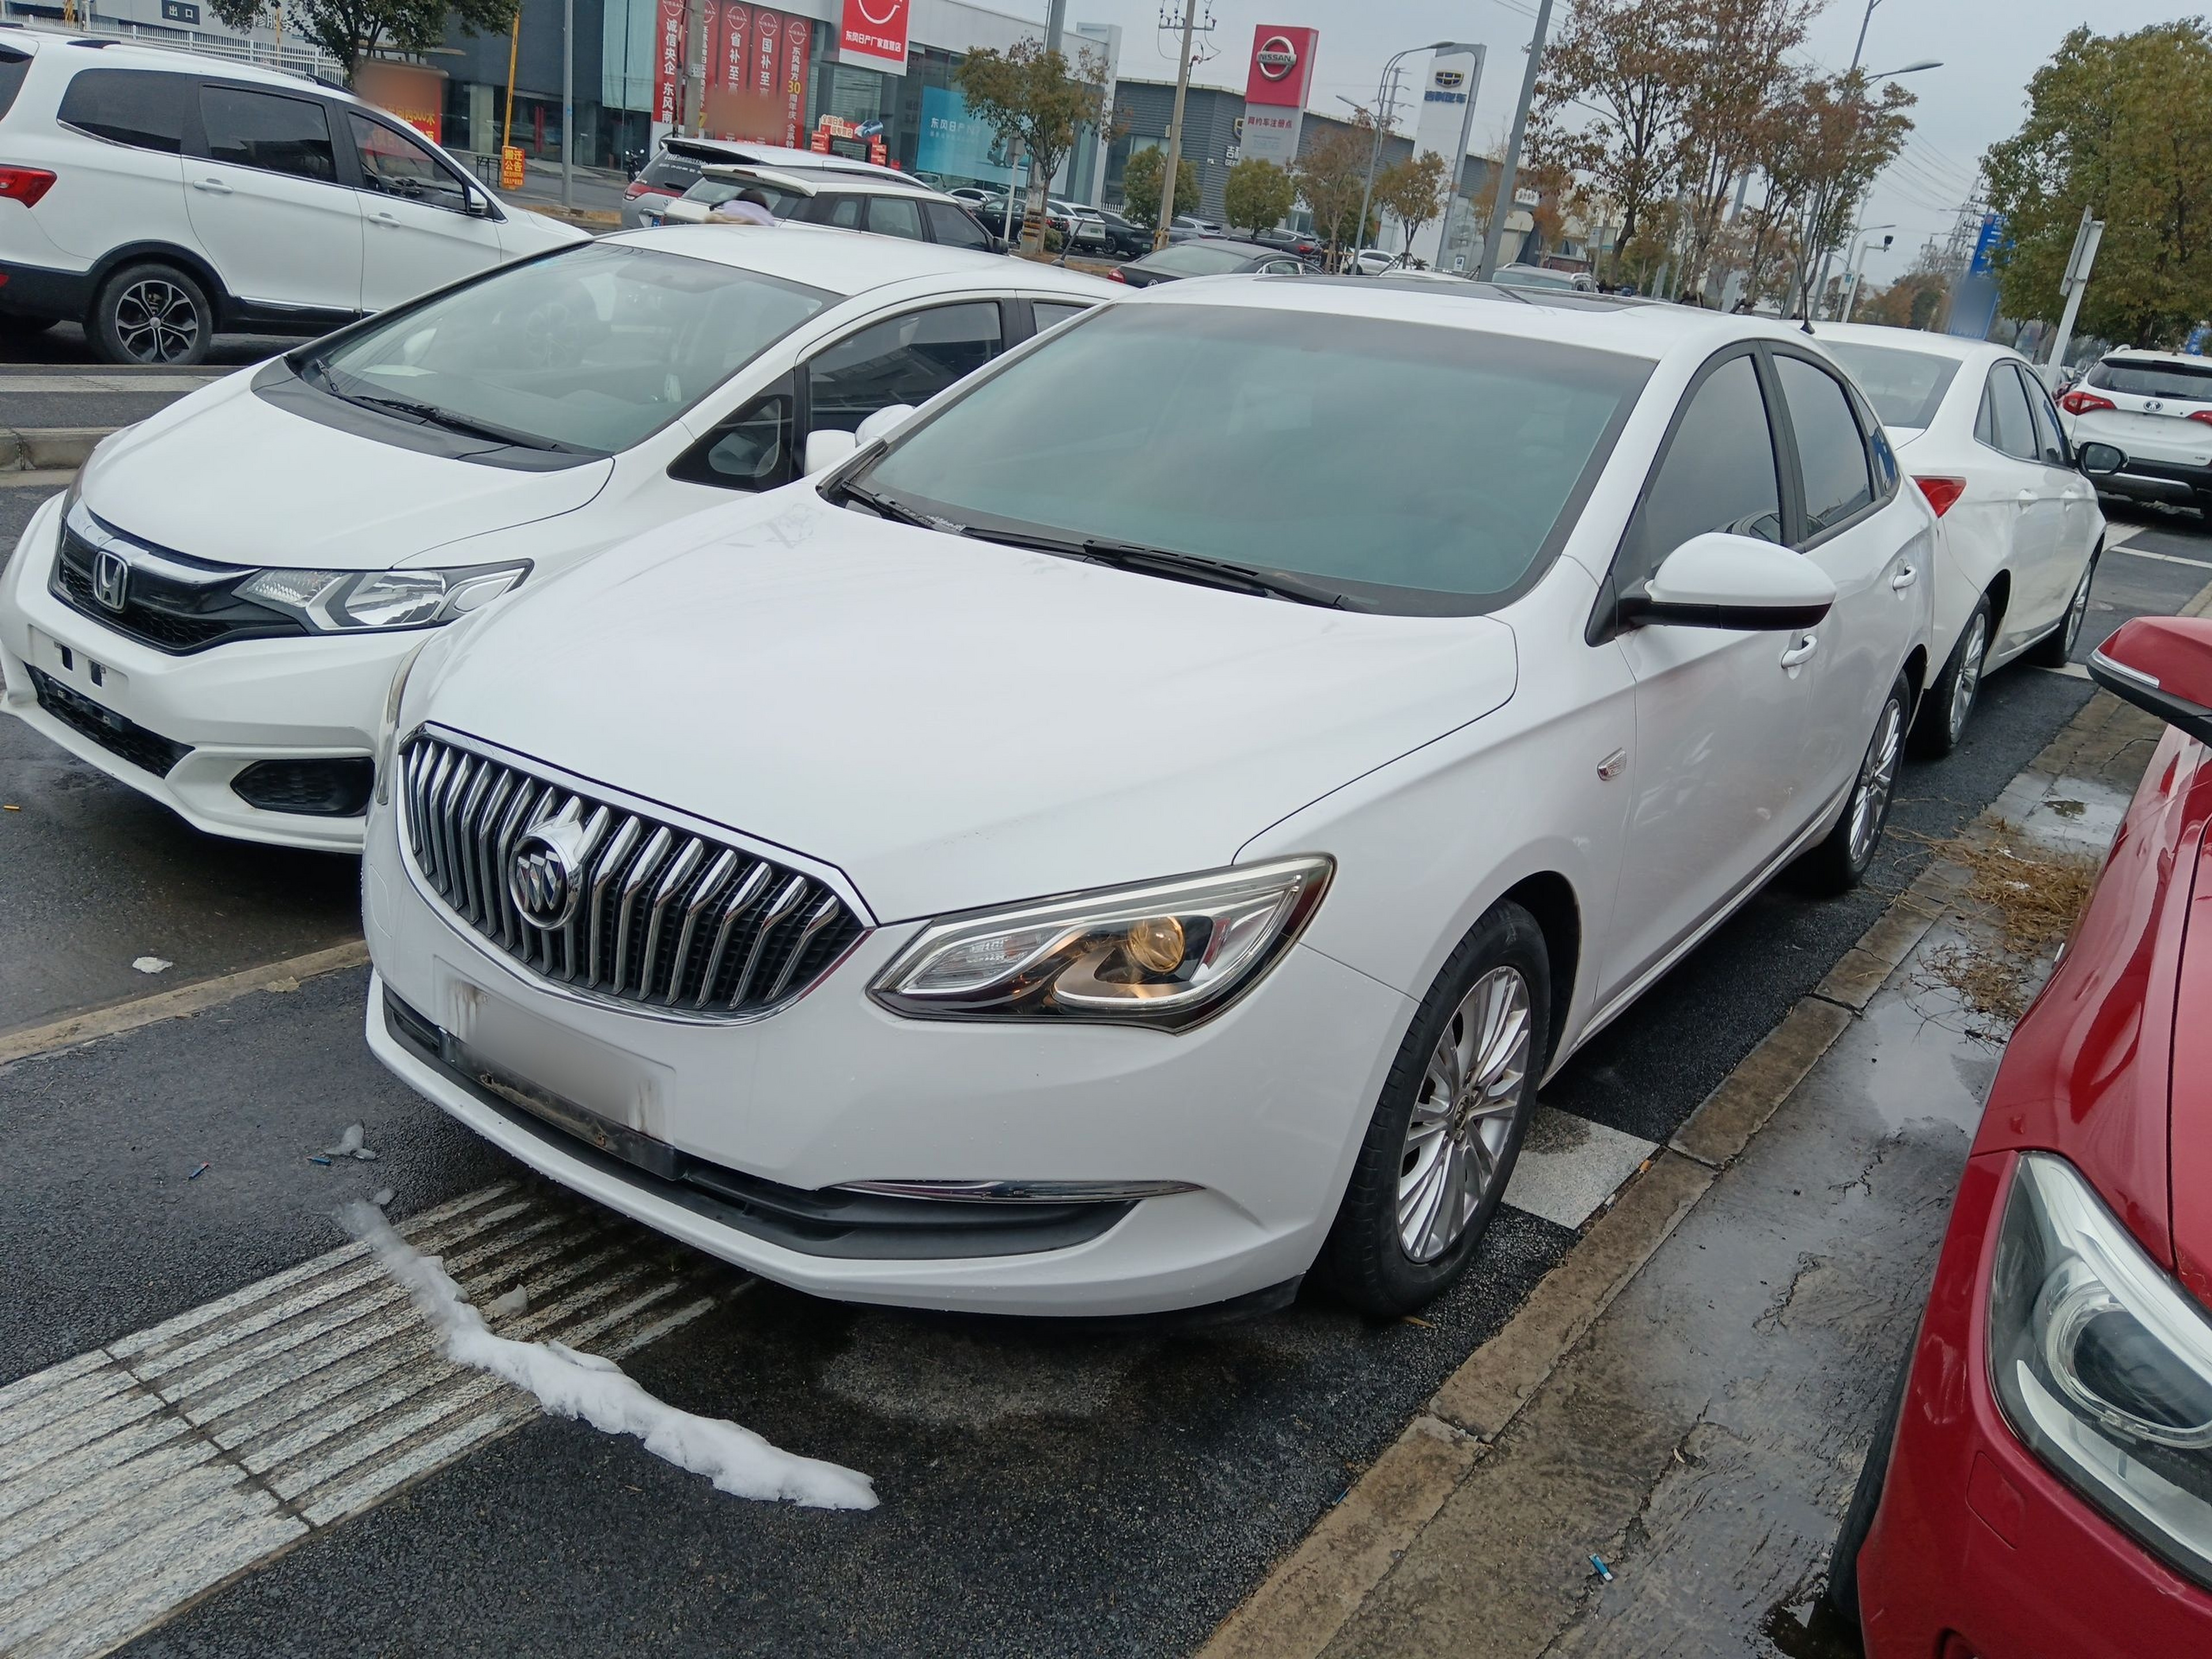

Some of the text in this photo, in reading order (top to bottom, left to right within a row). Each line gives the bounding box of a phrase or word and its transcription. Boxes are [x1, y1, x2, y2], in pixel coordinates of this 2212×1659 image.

[169, 5, 194, 18] 出口
[727, 14, 747, 22] NISSAN
[759, 20, 778, 28] NISSAN
[789, 29, 807, 37] NISSAN
[664, 18, 678, 75] 诚信央企
[845, 30, 902, 52] 东风日产厂家直营店
[1259, 53, 1291, 62] NISSAN
[1248, 116, 1292, 129] 网约车注册点
[505, 160, 522, 172] 公告
